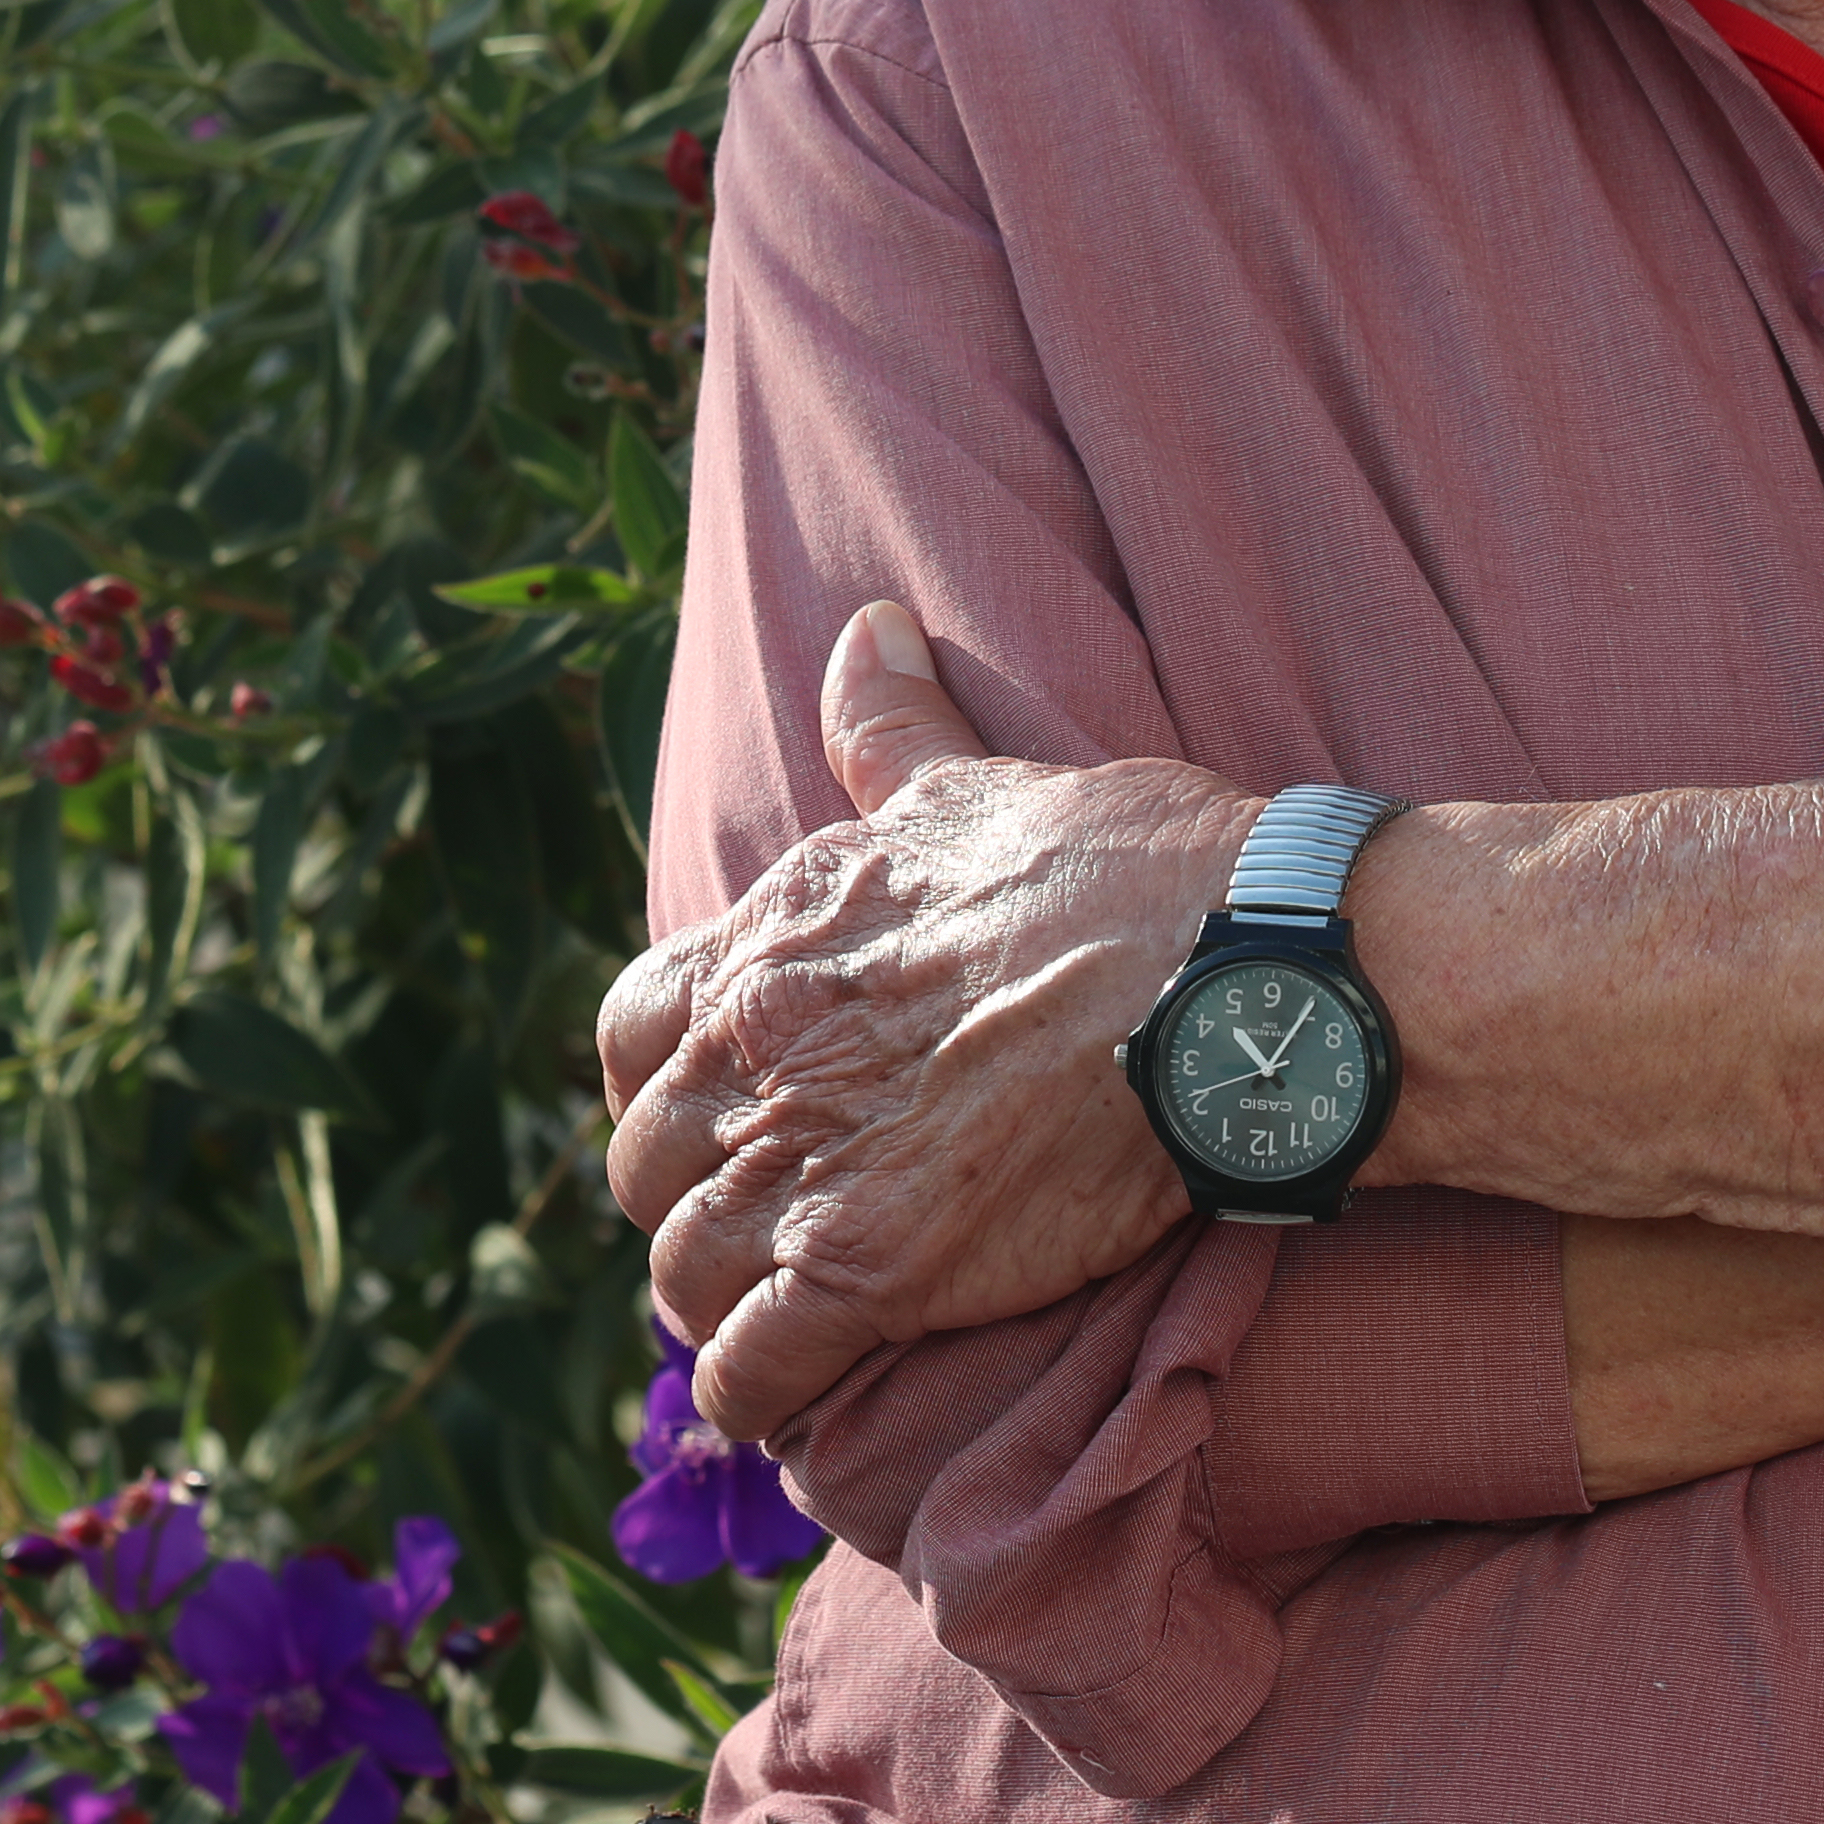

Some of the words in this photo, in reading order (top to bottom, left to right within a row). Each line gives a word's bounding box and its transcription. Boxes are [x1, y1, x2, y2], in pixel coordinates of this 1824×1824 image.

[1225, 988, 1243, 1014] 5
[1263, 982, 1281, 1008] 6
[1196, 1013, 1215, 1038] 4
[1325, 1022, 1342, 1049] 8
[1182, 1049, 1200, 1076] 3
[1335, 1062, 1353, 1088] 9
[1192, 1088, 1210, 1115] 2
[1240, 1098, 1292, 1112] CASIO
[1311, 1095, 1340, 1121] 10
[1222, 1117, 1232, 1143] 1
[1249, 1129, 1278, 1156] 12
[1290, 1122, 1313, 1148] 11
